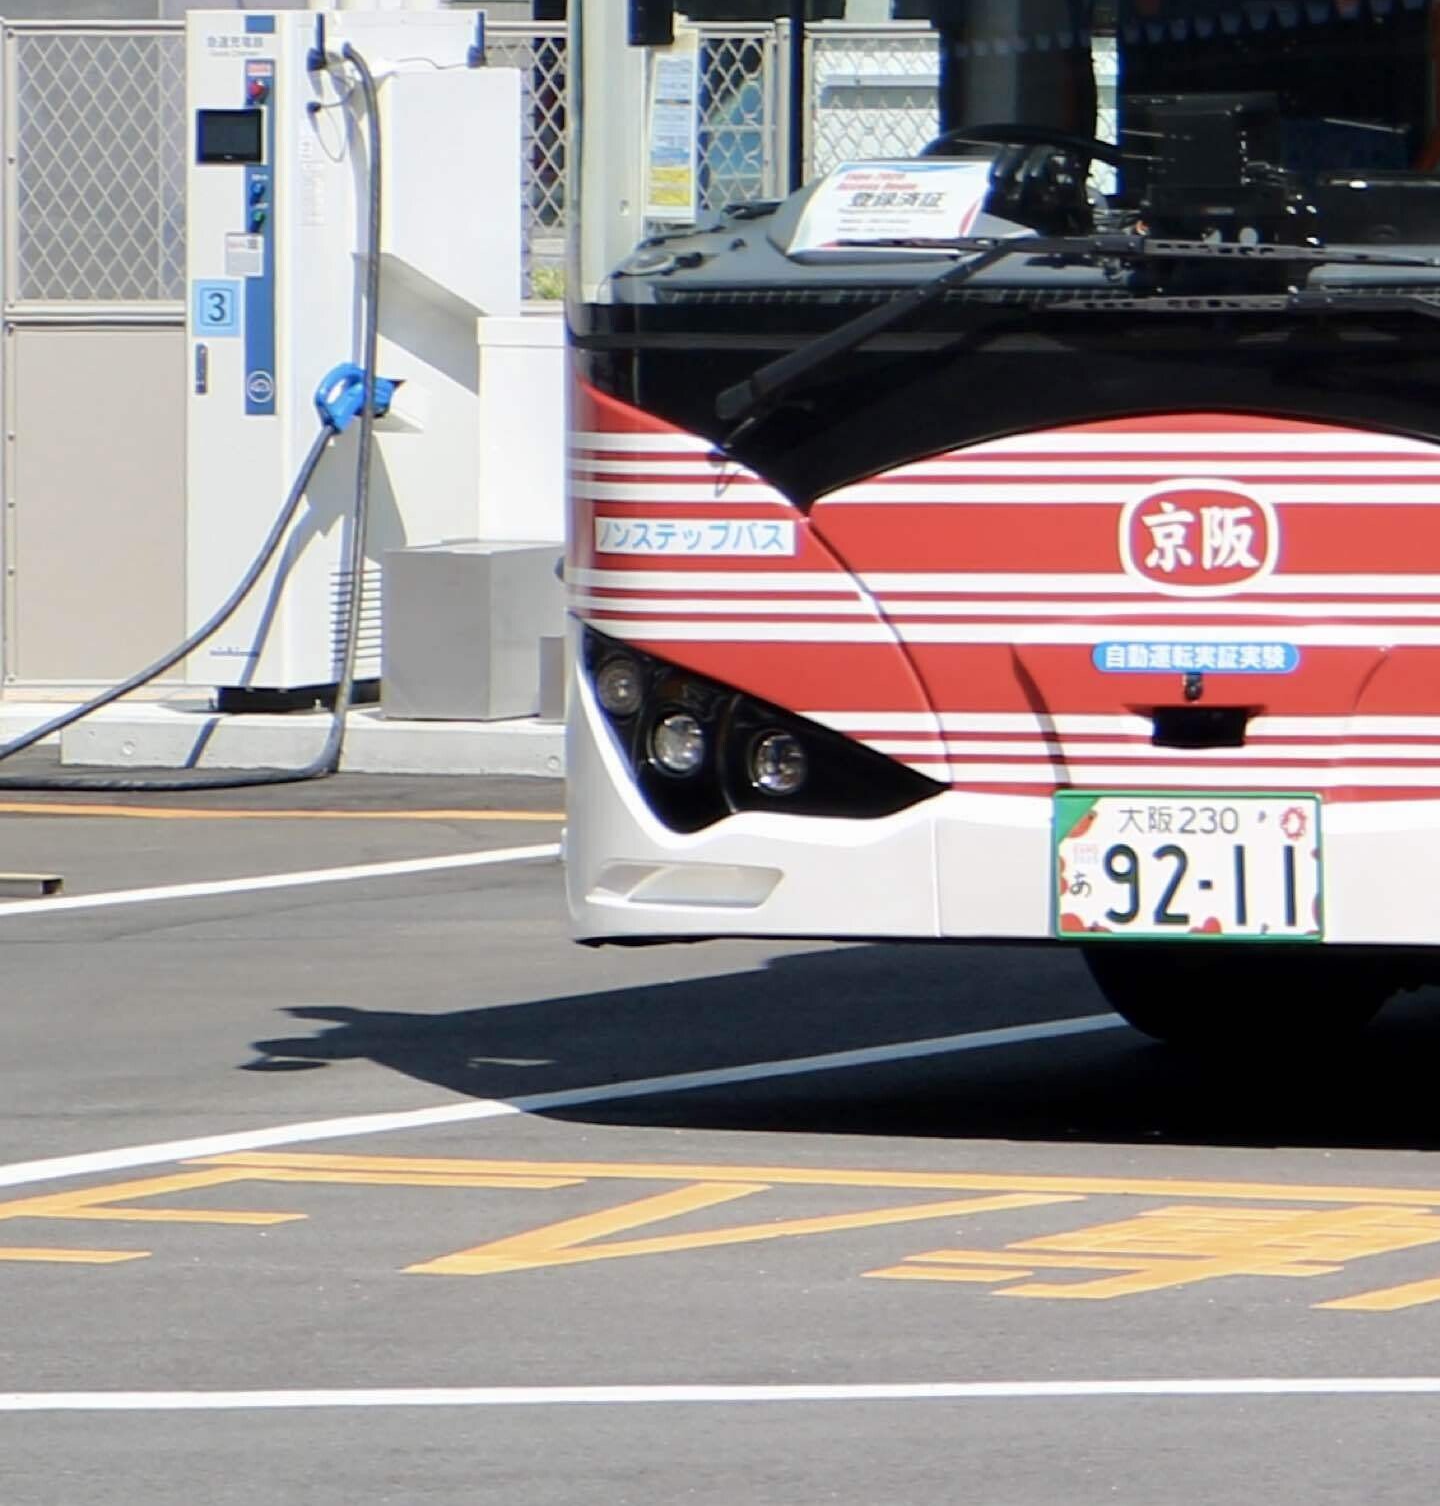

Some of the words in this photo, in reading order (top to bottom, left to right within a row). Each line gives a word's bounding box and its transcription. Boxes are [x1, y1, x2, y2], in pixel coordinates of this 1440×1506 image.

[208, 292, 226, 322] 3
[599, 521, 785, 552] ノンステップバス
[1140, 501, 1261, 573] 京阪
[1104, 644, 1286, 670] 自動運転実証実験
[1069, 870, 1093, 898] あ
[1103, 843, 1297, 927] 92-11
